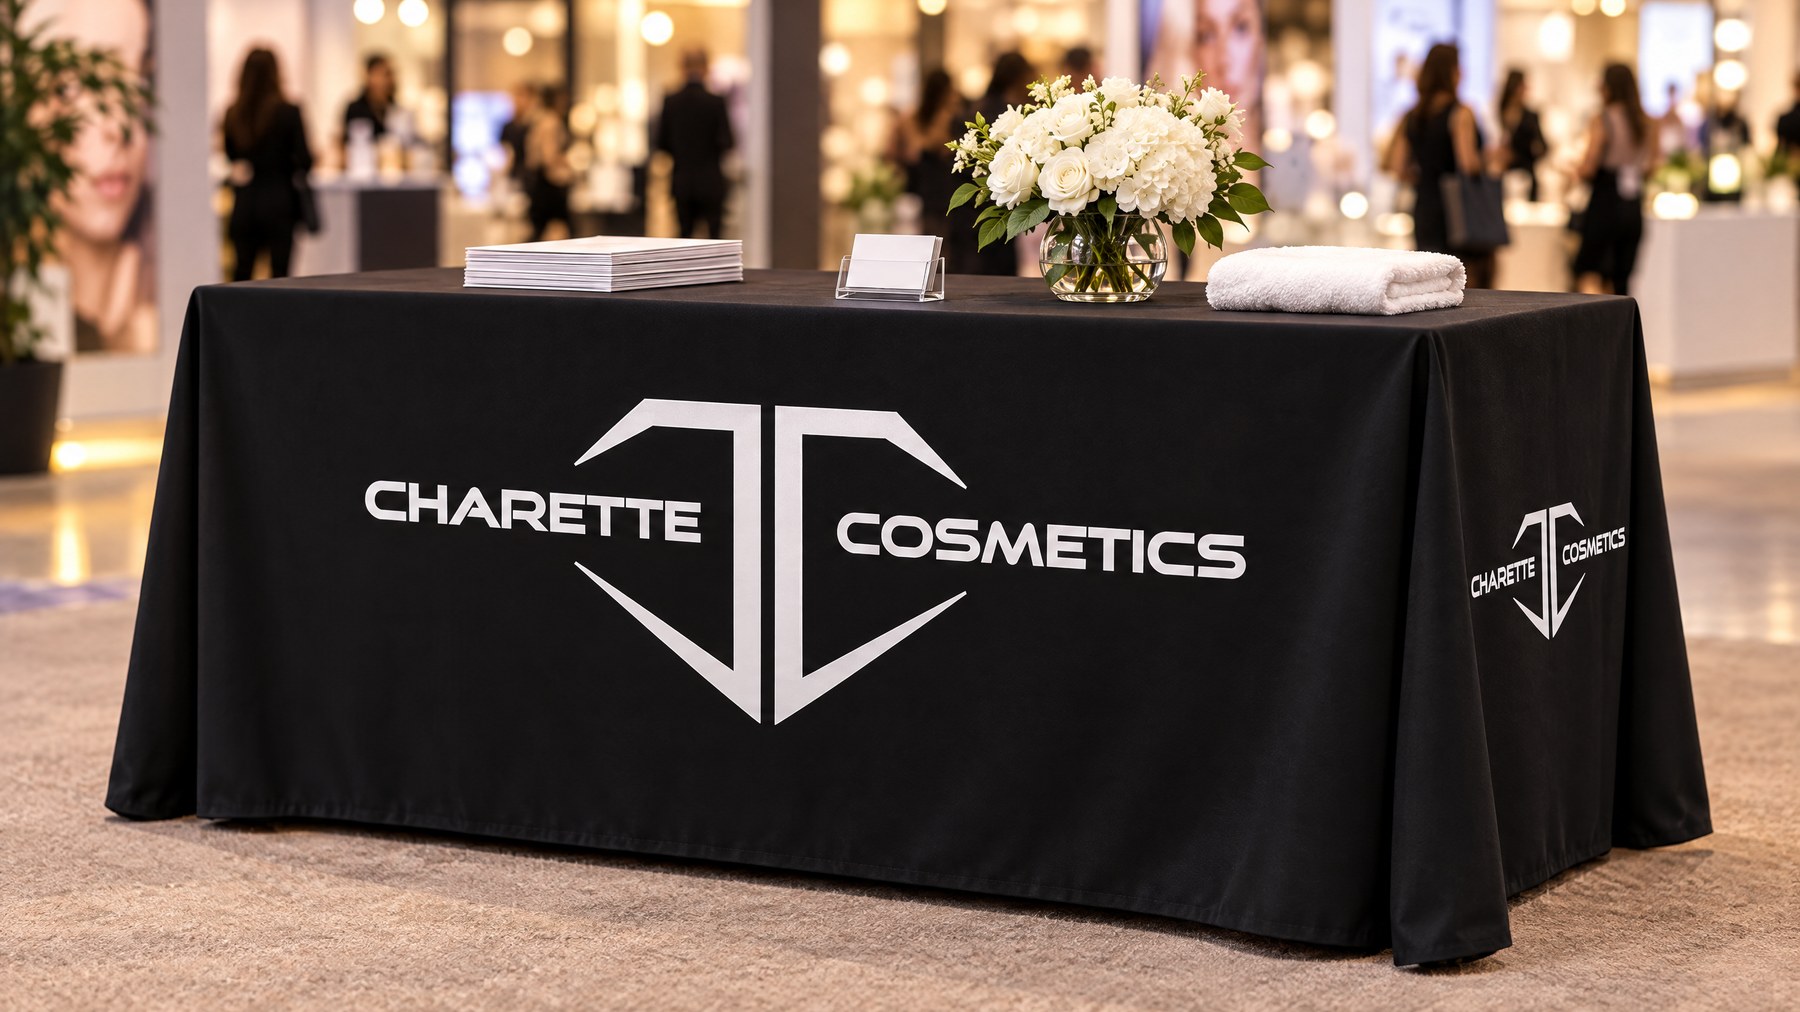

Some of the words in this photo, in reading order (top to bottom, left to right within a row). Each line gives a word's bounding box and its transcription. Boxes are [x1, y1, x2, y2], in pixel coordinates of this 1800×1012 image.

[364, 480, 702, 544] CHARETTE
[836, 512, 1247, 580] COSMETICS
[1470, 556, 1536, 599] CHARETTE
[1562, 526, 1626, 566] COSMETICS
